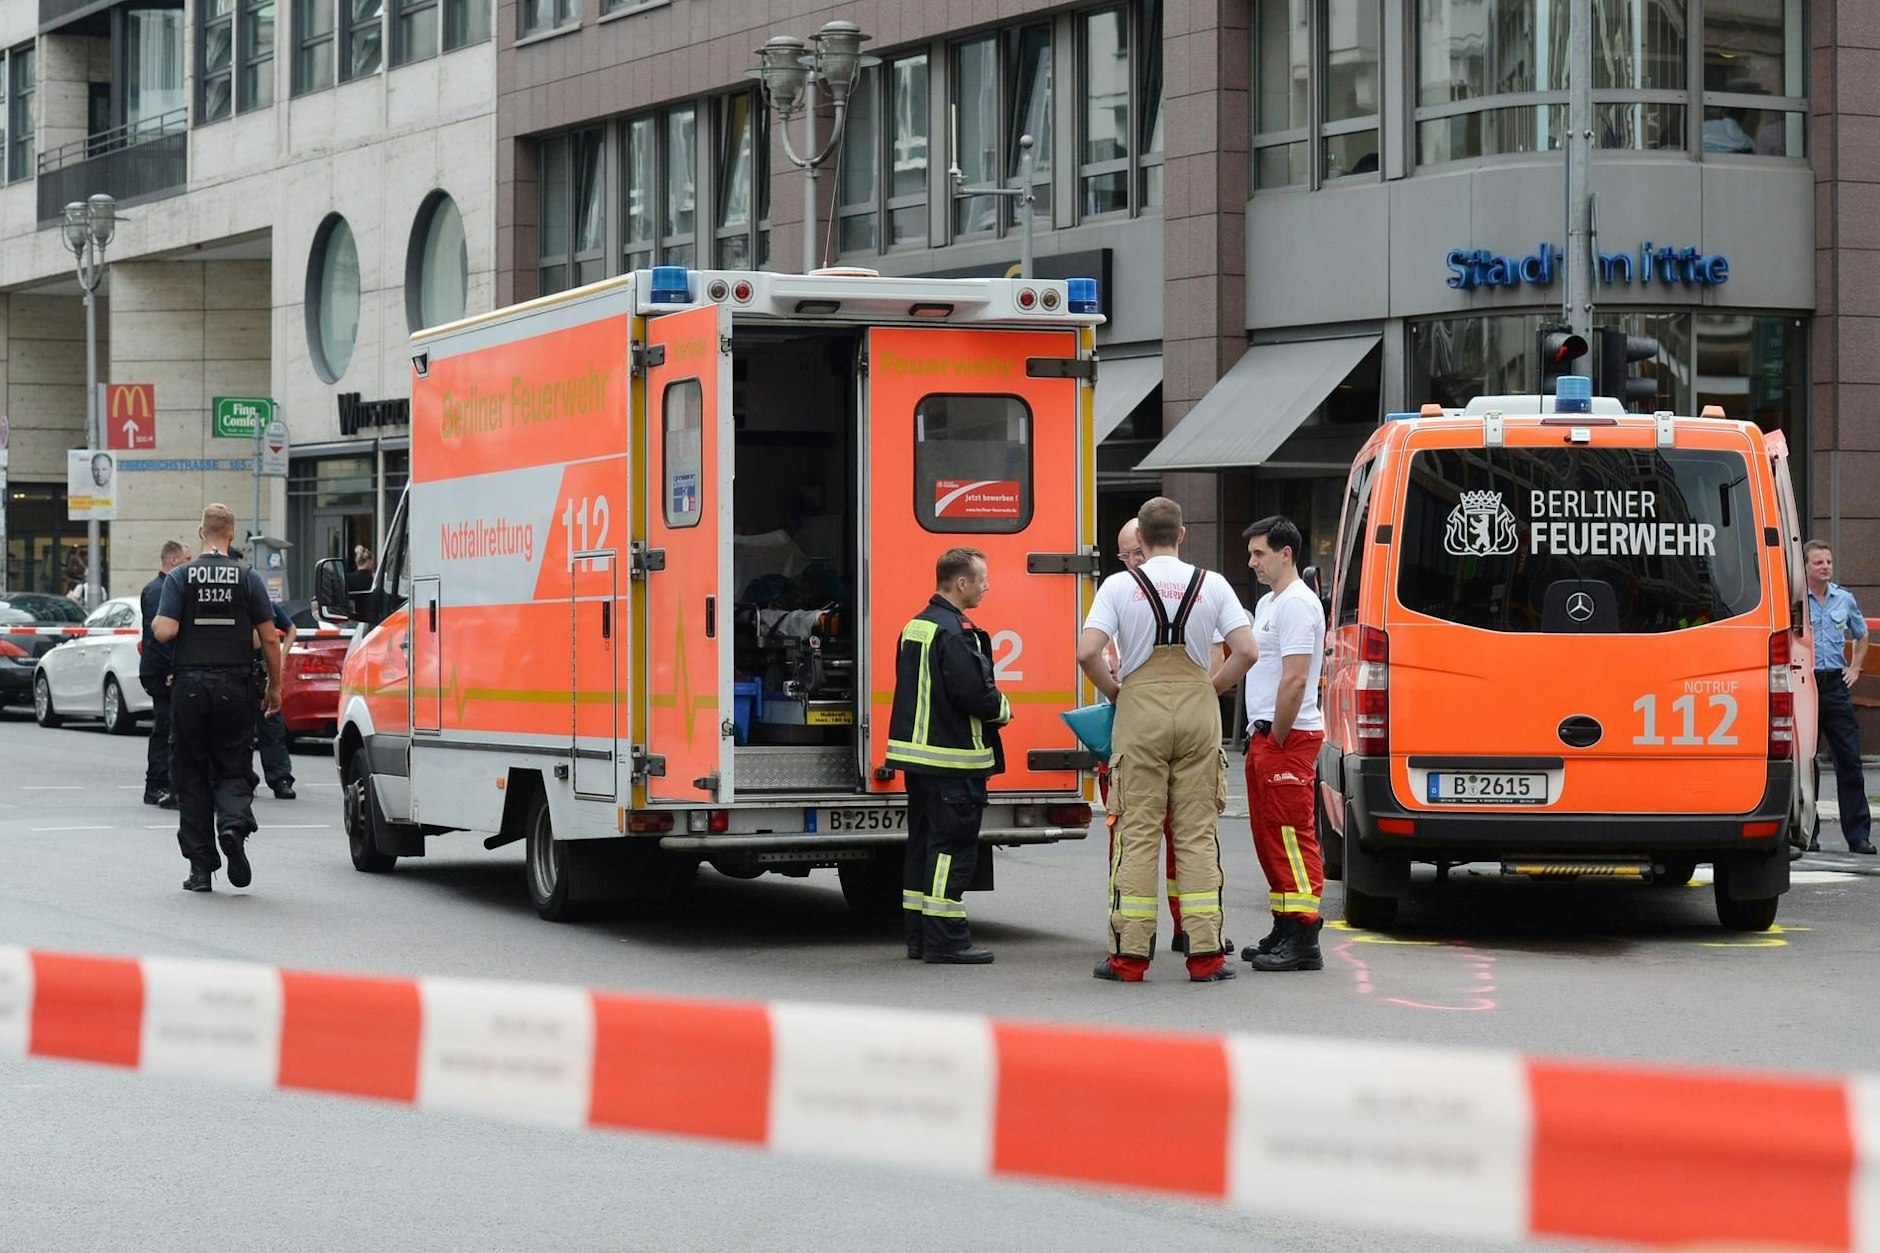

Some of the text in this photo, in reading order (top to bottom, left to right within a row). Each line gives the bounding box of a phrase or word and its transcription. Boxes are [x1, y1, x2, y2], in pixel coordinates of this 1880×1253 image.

[1446, 242, 1729, 289] Stadmitte
[880, 351, 1014, 377] Feuerwehr
[233, 403, 256, 415] Finn
[442, 362, 609, 440] Berliner Feuerwehr
[223, 414, 266, 428] Comfot
[965, 494, 981, 502] Jetzt
[983, 494, 1014, 502] bewerben
[1531, 490, 1656, 518] BERLINER
[441, 518, 533, 562] Notfallrettung
[562, 494, 609, 573] 112
[1531, 522, 1717, 556] FEUERWEHR
[188, 566, 239, 584] POLIZEI
[198, 588, 232, 602] 13124
[1684, 681, 1738, 694] NOTRUF
[1632, 694, 1738, 745] 112
[1454, 777, 1466, 795] B
[1480, 777, 1530, 795] 2615
[831, 811, 841, 830] B
[855, 810, 906, 829] 2567
